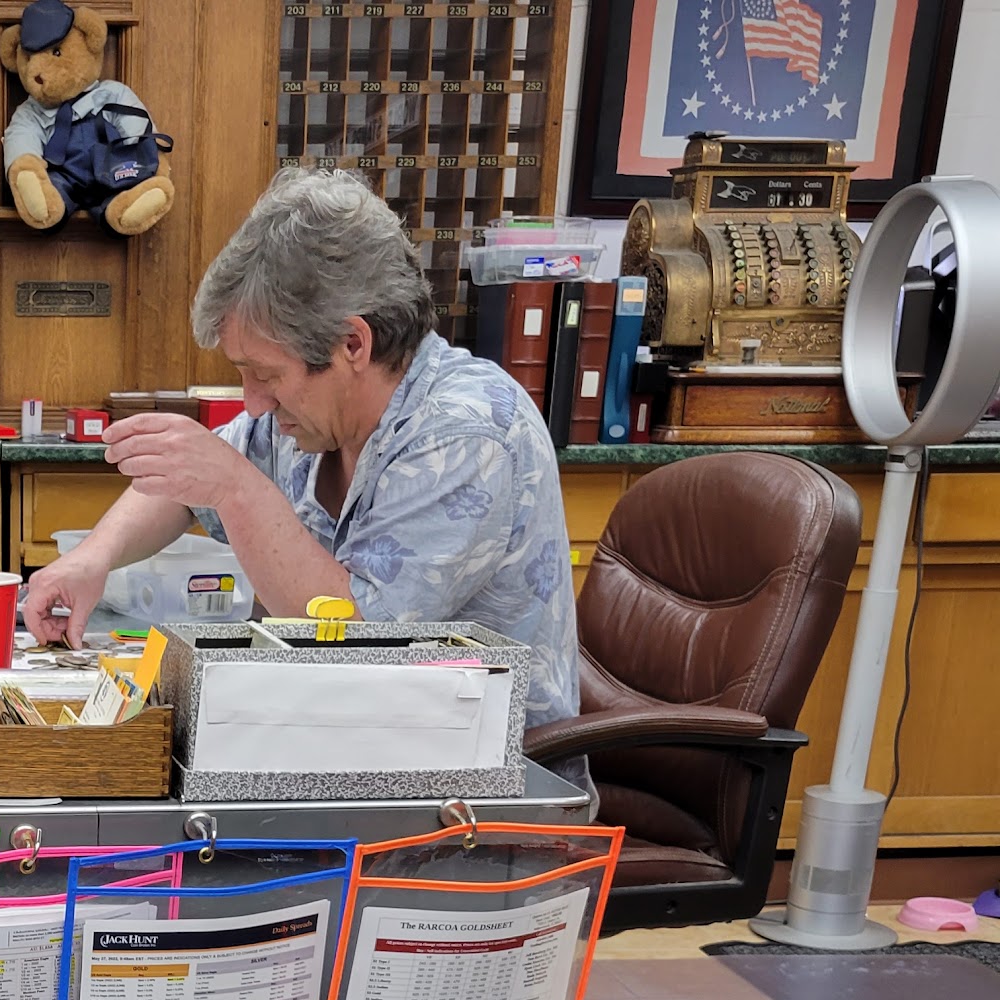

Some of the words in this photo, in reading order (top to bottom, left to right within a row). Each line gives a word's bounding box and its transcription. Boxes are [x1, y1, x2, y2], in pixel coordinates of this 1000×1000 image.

[287, 6, 304, 14] 203
[325, 6, 340, 14] 211
[366, 6, 382, 15] 219
[406, 6, 422, 14] 227
[450, 6, 466, 14] 235
[490, 6, 508, 14] 243
[529, 6, 546, 14] 251
[284, 83, 302, 91] 204
[322, 83, 338, 92] 212
[363, 82, 380, 90] 220
[402, 82, 418, 91] 228
[443, 83, 460, 91] 236
[486, 82, 502, 90] 244
[319, 159, 335, 167] 213
[398, 158, 414, 166] 229
[440, 158, 456, 166] 237
[760, 394, 830, 416] National
[272, 926, 288, 935] Daily
[290, 920, 312, 932] Spreads
[418, 922, 458, 931] RARCOA
[460, 921, 514, 931] GOLDSHEET
[101, 934, 128, 946] JACK
[129, 934, 158, 944] HUNT
